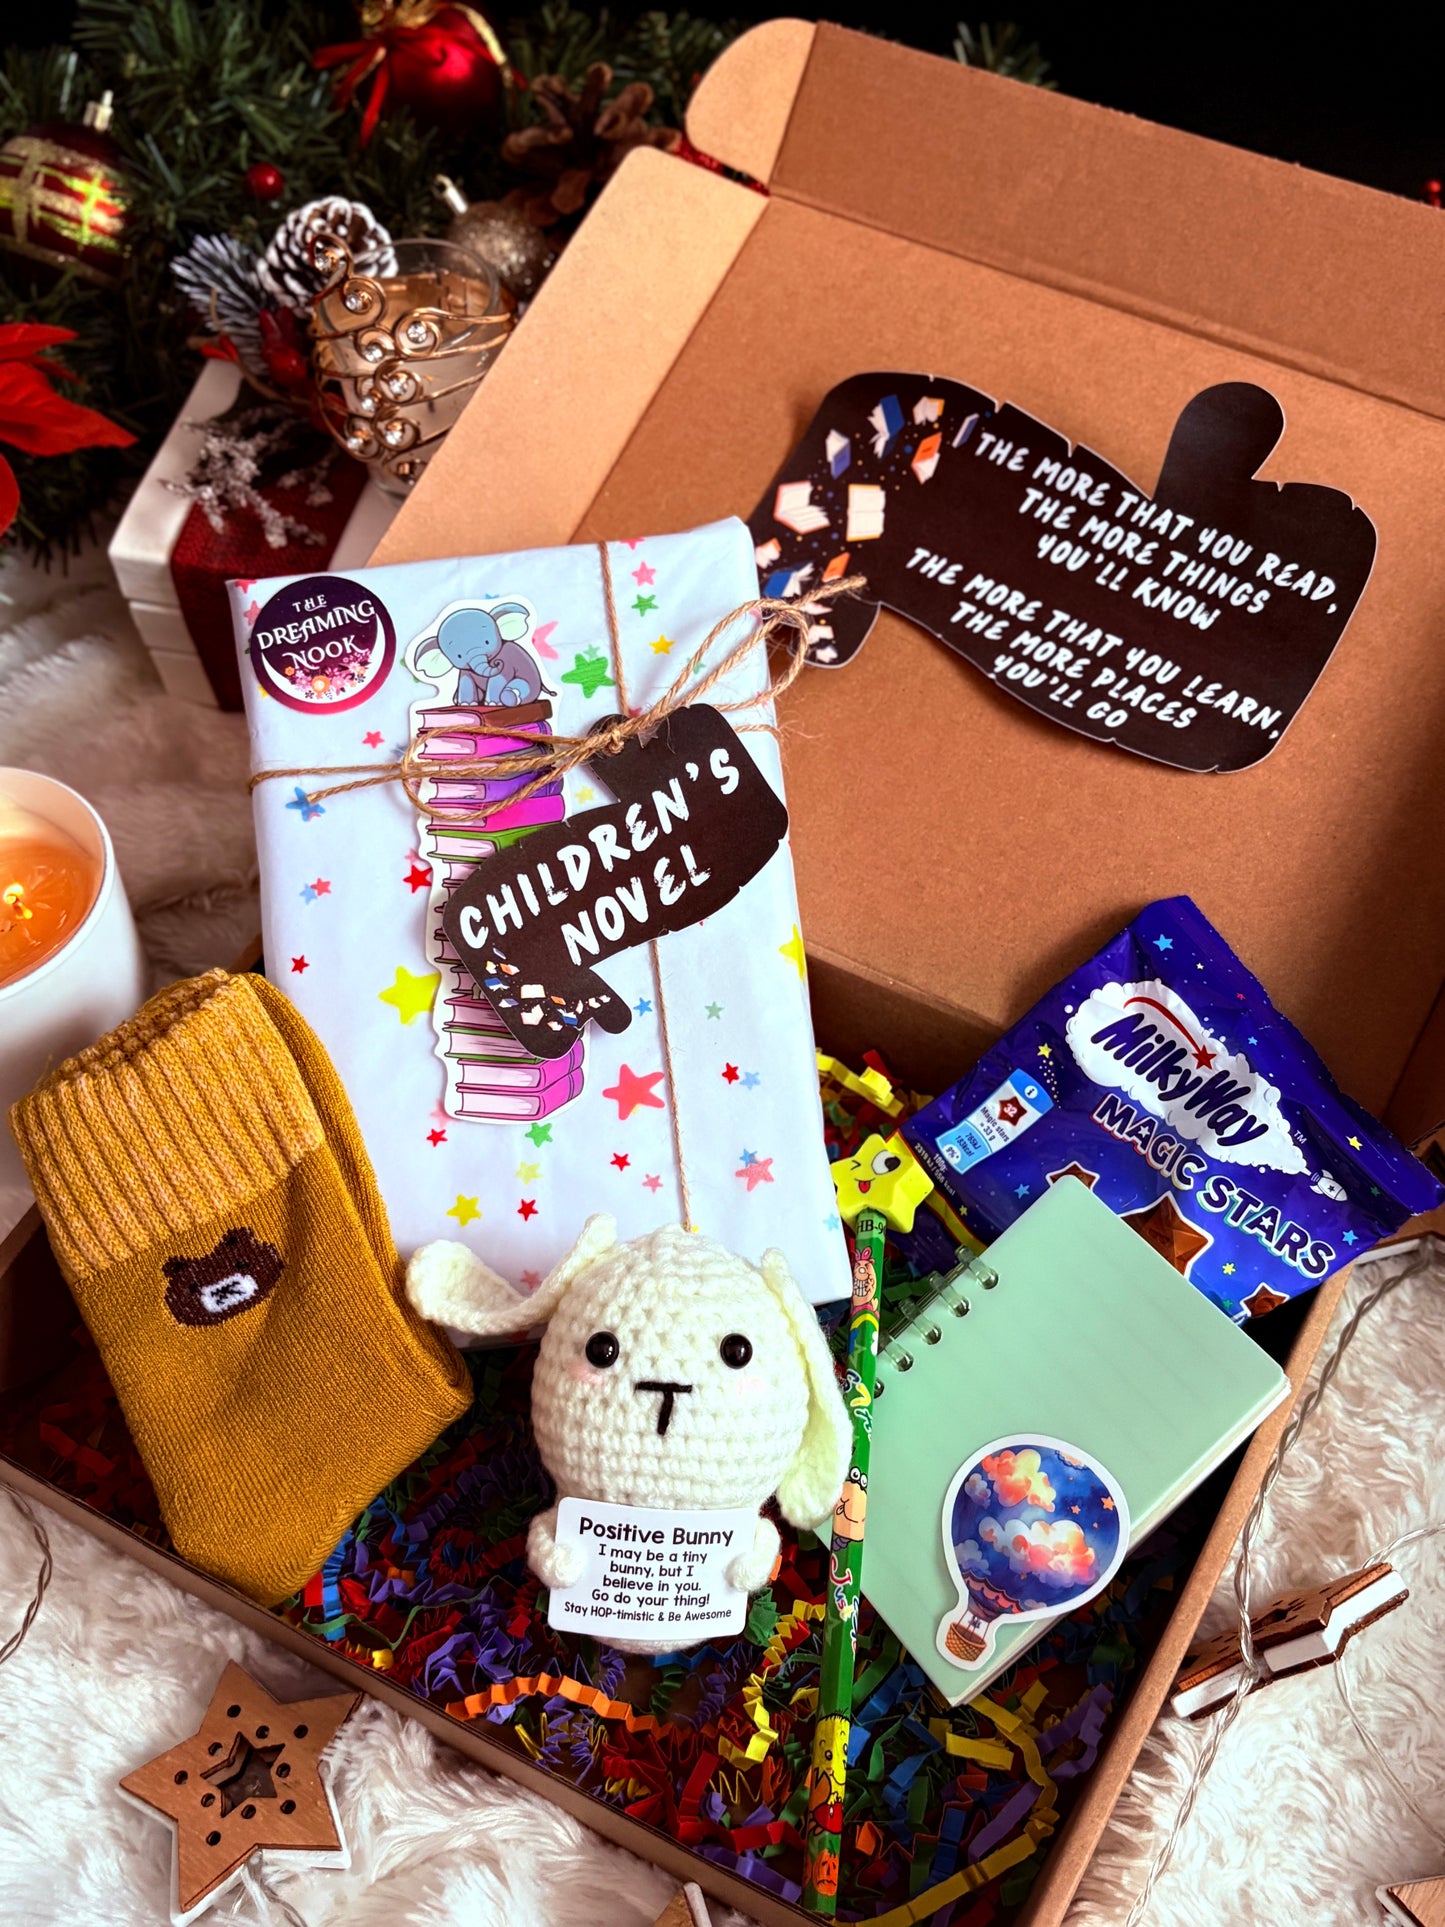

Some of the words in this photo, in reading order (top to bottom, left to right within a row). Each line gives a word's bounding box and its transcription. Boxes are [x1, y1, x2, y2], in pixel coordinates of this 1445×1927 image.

[974, 433, 1029, 471] THE
[1032, 457, 1110, 506] MORE
[1115, 491, 1194, 541] THAT
[1198, 528, 1253, 566] YOU
[1256, 553, 1337, 614] READ,
[1019, 488, 1077, 529] THE
[1078, 515, 1159, 565] MORE
[1162, 551, 1271, 614] THINGS
[1037, 534, 1129, 592] YOU'LL
[1132, 577, 1221, 631] KNOW
[292, 594, 327, 612] THE
[257, 600, 375, 650] DREAMING
[282, 635, 369, 670] NOOK
[905, 547, 964, 585] THE
[962, 573, 1043, 622] MORE
[1044, 609, 1124, 657] THAT
[1125, 647, 1182, 684] YOU
[1182, 674, 1282, 739] LEARN,
[950, 601, 1010, 640] THE
[1009, 630, 1091, 678] MORE
[1091, 667, 1198, 729] PLACES
[993, 654, 1083, 708] YOU'LL
[1086, 701, 1128, 728] GO
[459, 748, 740, 949] CHILDREN'S
[561, 844, 711, 966] NOVEL
[980, 1106, 997, 1127] Magic
[996, 1126, 1010, 1142] stars
[1003, 1103, 1018, 1118] 32
[983, 1126, 993, 1135] 33
[1293, 1130, 1307, 1145] TM
[1091, 1093, 1207, 1189] MAGIC
[1197, 1176, 1336, 1278] STARS
[579, 1516, 665, 1544] Positive
[672, 1527, 734, 1547] Bunny
[598, 1543, 607, 1556] I
[610, 1548, 641, 1562] may
[646, 1549, 664, 1561] be
[669, 1553, 678, 1562] a
[682, 1551, 707, 1564] tiny
[609, 1560, 655, 1578] bunny,
[659, 1565, 682, 1577] but
[686, 1565, 694, 1577] I
[591, 1589, 609, 1601] Go
[614, 1591, 631, 1604] do
[636, 1594, 668, 1608] your
[673, 1593, 710, 1608] thing!
[602, 1575, 653, 1591] believe
[657, 1580, 669, 1592] in
[674, 1582, 701, 1598] you.
[564, 1601, 588, 1617] Stay
[590, 1606, 655, 1622] HOP-timistic
[658, 1611, 664, 1621] &
[669, 1612, 681, 1621] Be
[684, 1609, 732, 1621] Awesome
